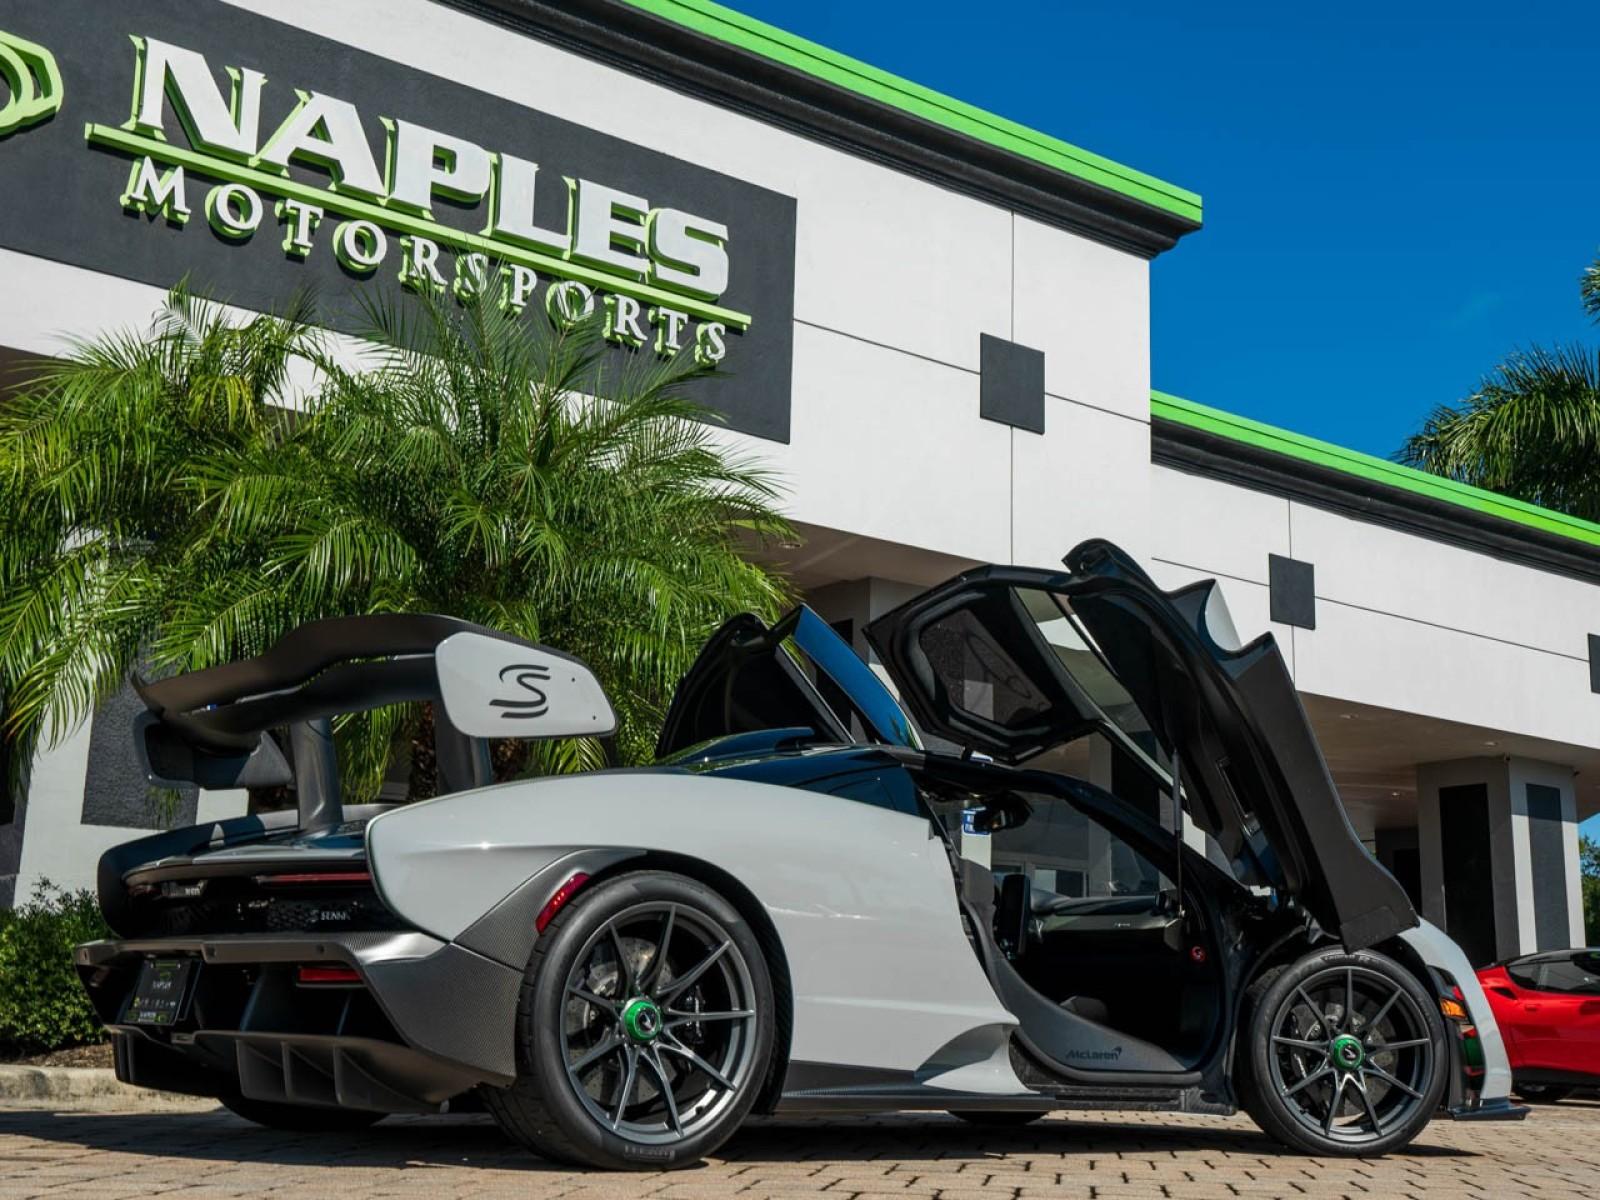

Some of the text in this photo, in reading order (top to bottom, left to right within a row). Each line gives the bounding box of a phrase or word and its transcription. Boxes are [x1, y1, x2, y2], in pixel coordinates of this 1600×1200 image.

[122, 155, 727, 363] MOTORSPORTS
[124, 34, 729, 299] NAPLES
[1065, 1047, 1121, 1061] McLaren
